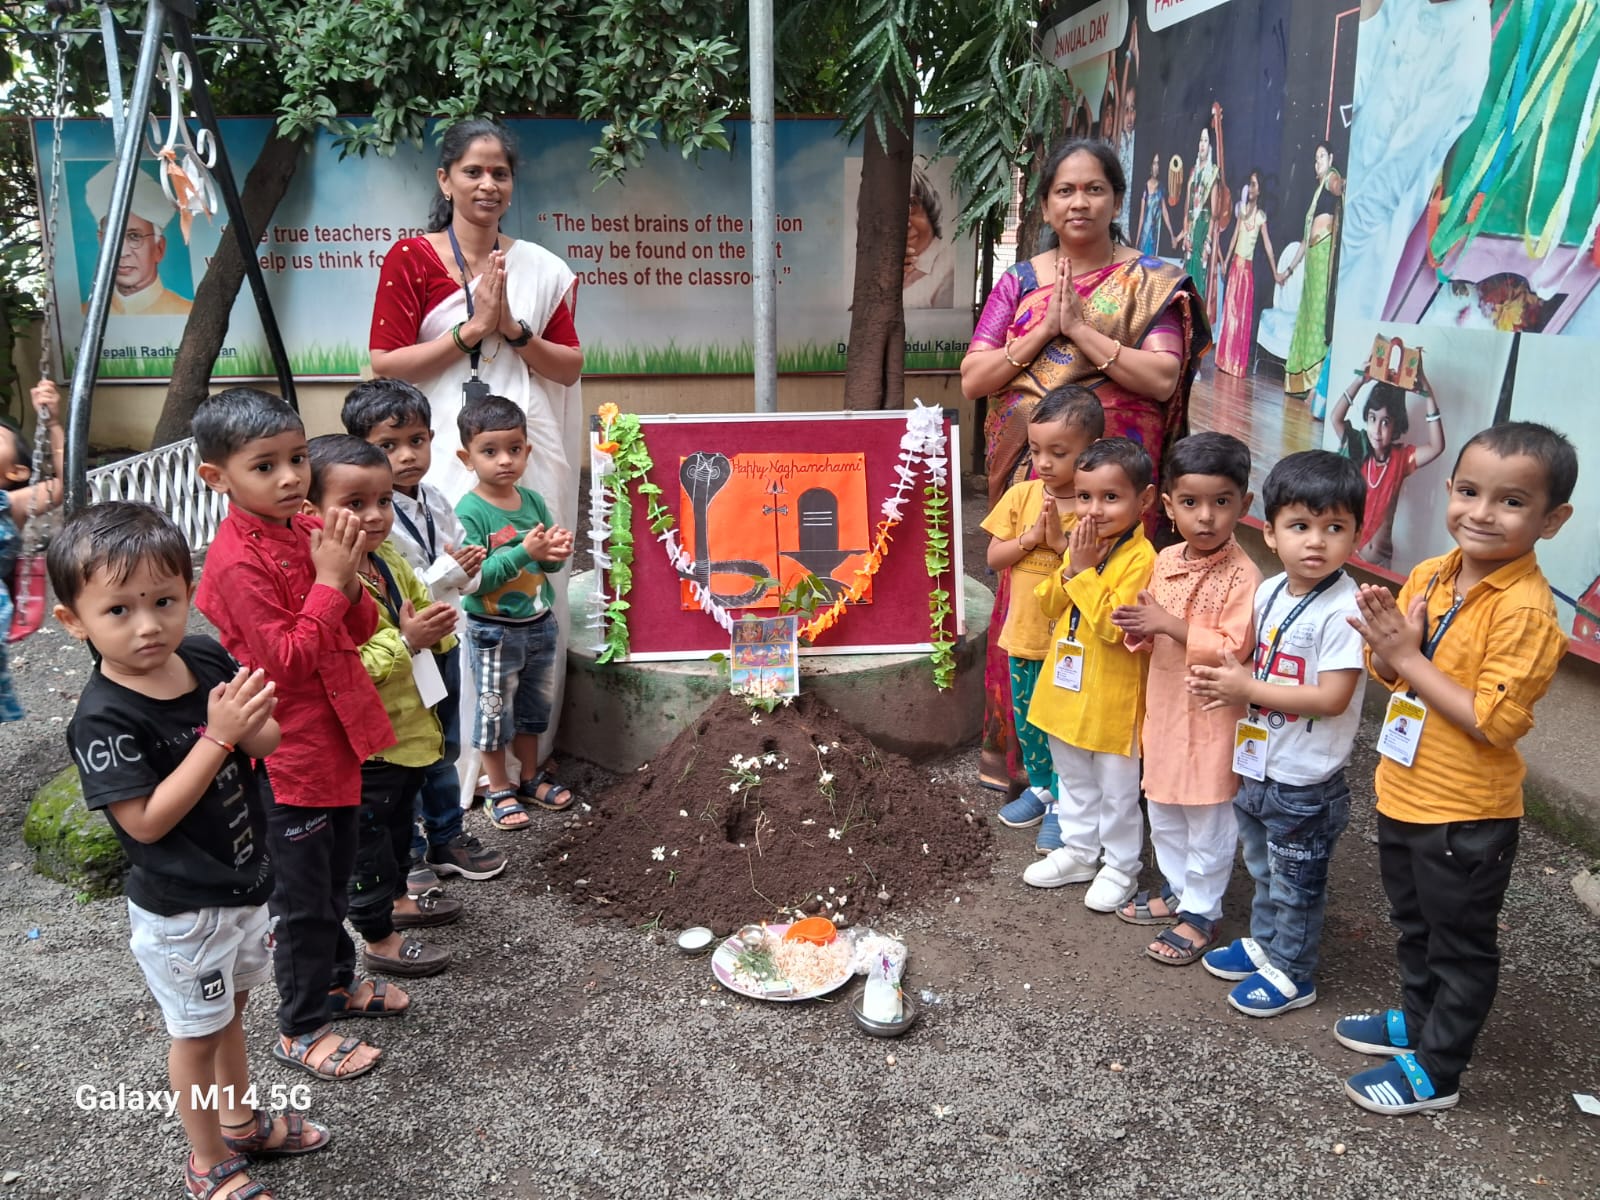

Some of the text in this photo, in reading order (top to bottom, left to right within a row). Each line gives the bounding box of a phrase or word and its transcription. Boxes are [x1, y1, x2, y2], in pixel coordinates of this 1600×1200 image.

[1054, 13, 1109, 60] ANNUAL DAY
[273, 226, 310, 243] true
[314, 224, 392, 242] teachers
[398, 226, 425, 240] are
[552, 213, 585, 232] The
[591, 214, 629, 233] best
[635, 213, 689, 233] brains
[695, 213, 712, 233] of
[717, 213, 743, 232] the
[259, 250, 384, 273] elp us think fo
[567, 244, 604, 263] may
[610, 241, 631, 259] be
[636, 241, 687, 259] found
[692, 244, 713, 259] on
[718, 241, 746, 259] the
[576, 267, 628, 285] nches
[634, 267, 651, 285] of
[656, 267, 683, 285] the
[904, 340, 931, 352] bdul
[732, 458, 768, 480] Happy
[75, 734, 142, 775] GIC
